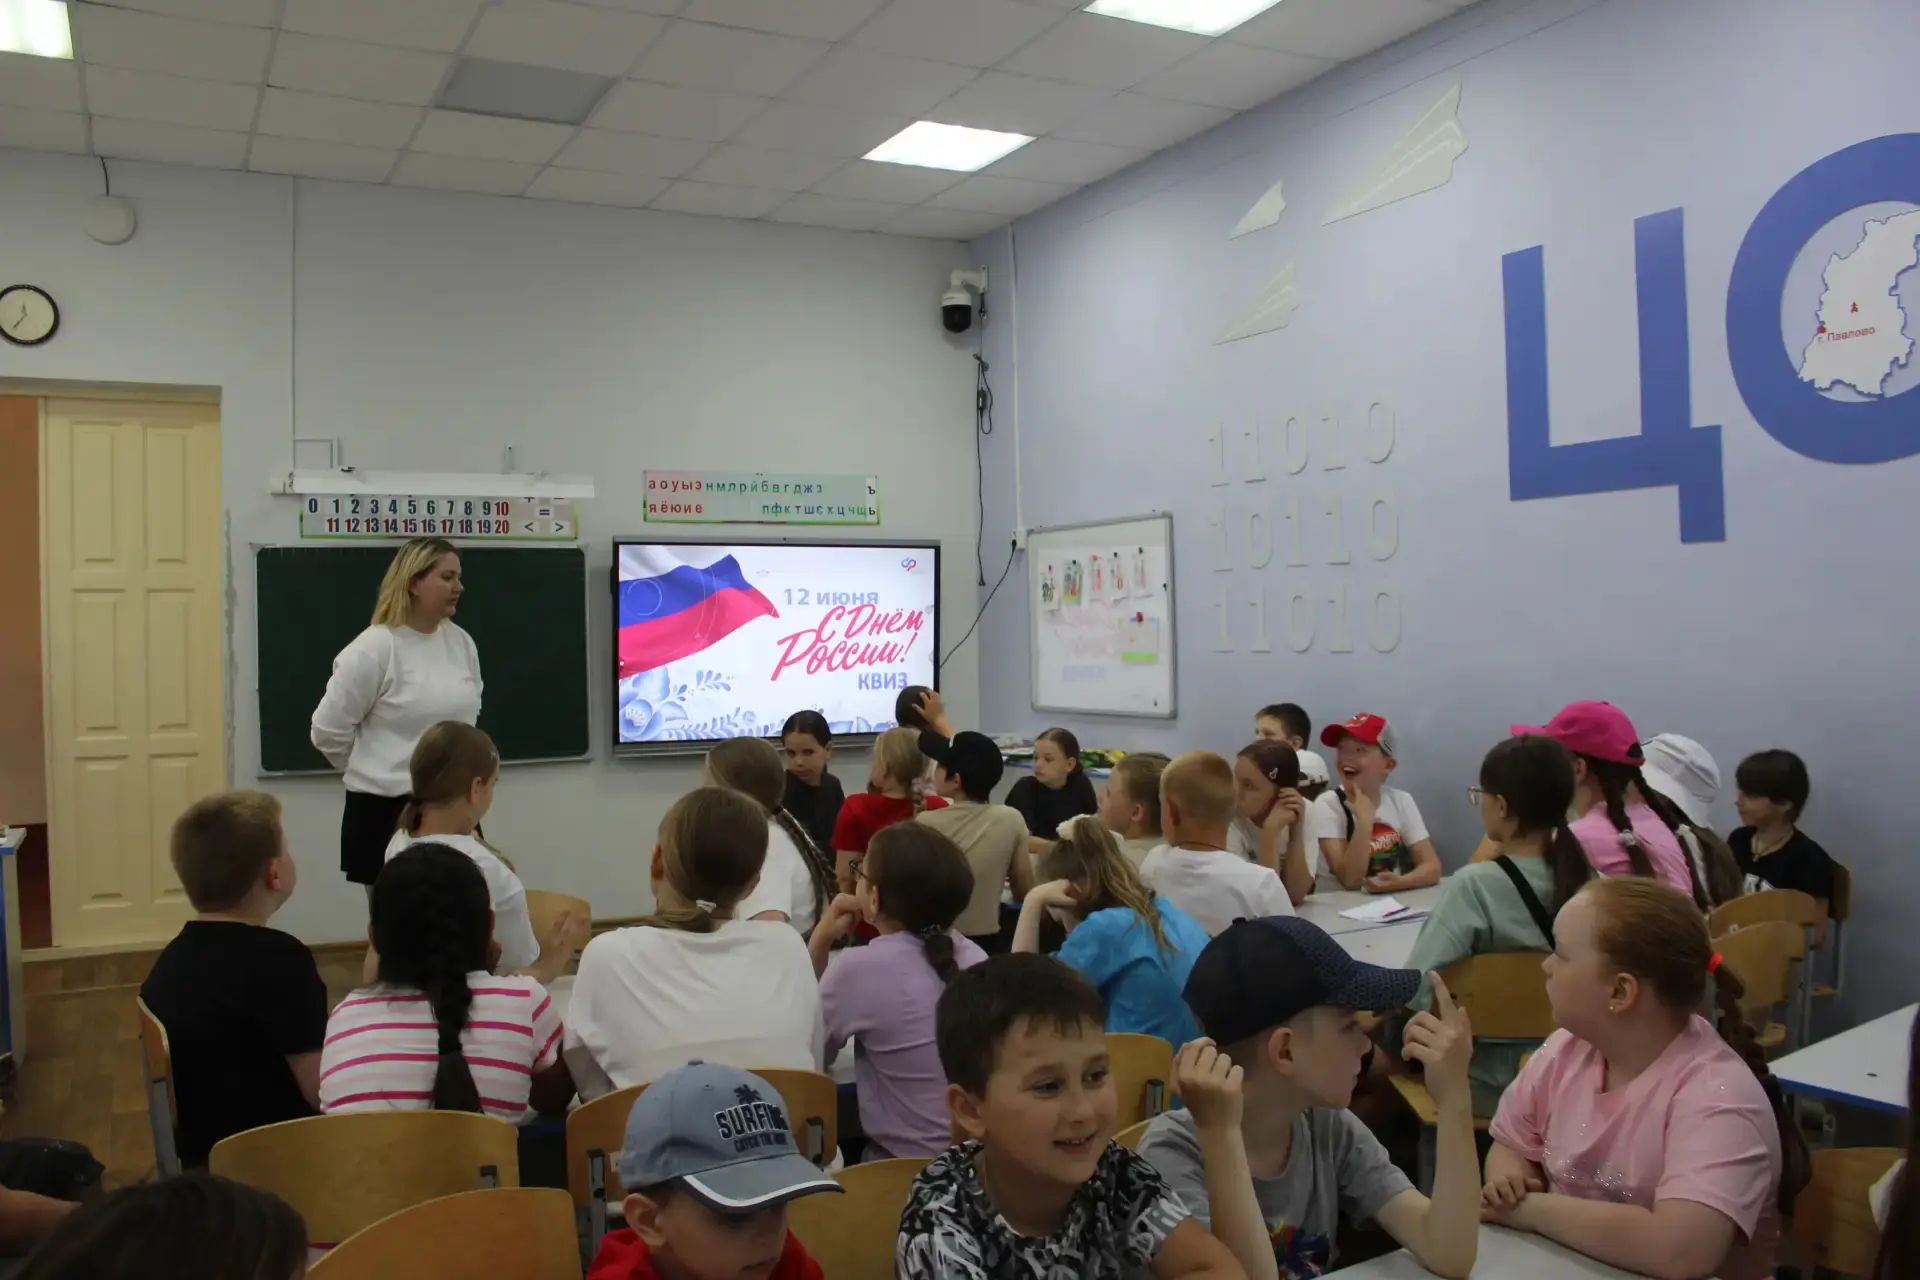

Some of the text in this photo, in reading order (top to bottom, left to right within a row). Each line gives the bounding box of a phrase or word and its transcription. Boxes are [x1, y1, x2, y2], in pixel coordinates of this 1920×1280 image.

[1827, 327, 1875, 341] Павлово
[308, 498, 509, 516] 0 1 2 3 4 5 6 7 8 9 10
[327, 517, 509, 534] 11 12 13 14 15 16 17 18 19 20
[783, 588, 879, 606] 12 июня
[844, 603, 924, 639] Днём
[770, 628, 918, 682] России!
[858, 672, 908, 690] КВИЗ
[714, 1102, 789, 1140] SURFI
